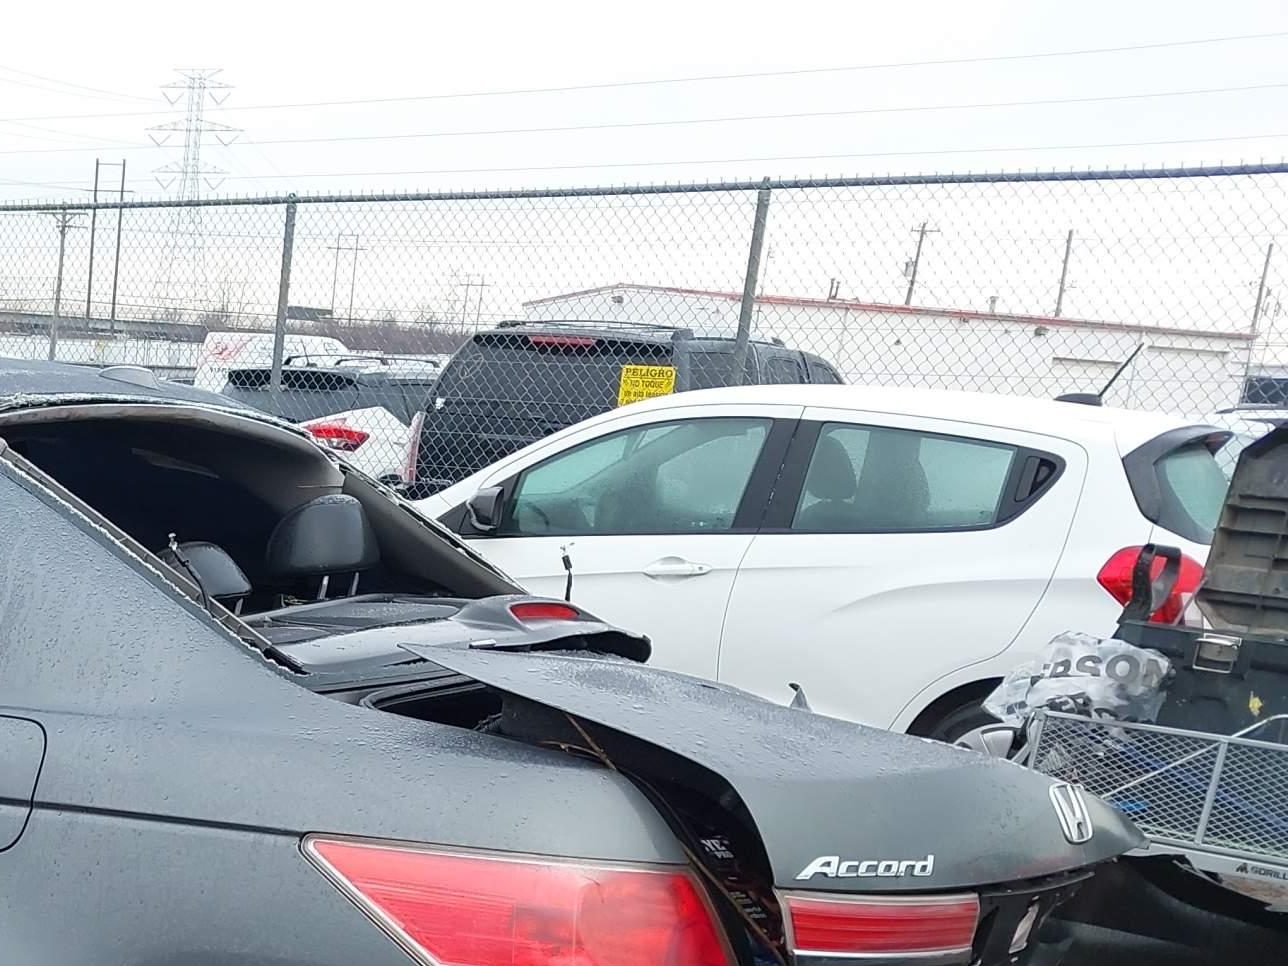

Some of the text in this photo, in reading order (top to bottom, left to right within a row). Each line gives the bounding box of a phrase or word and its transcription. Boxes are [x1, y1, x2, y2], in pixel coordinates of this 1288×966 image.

[624, 366, 673, 378] PELIGRO
[630, 380, 665, 390] NO TOQUE
[794, 854, 935, 881] Accord
